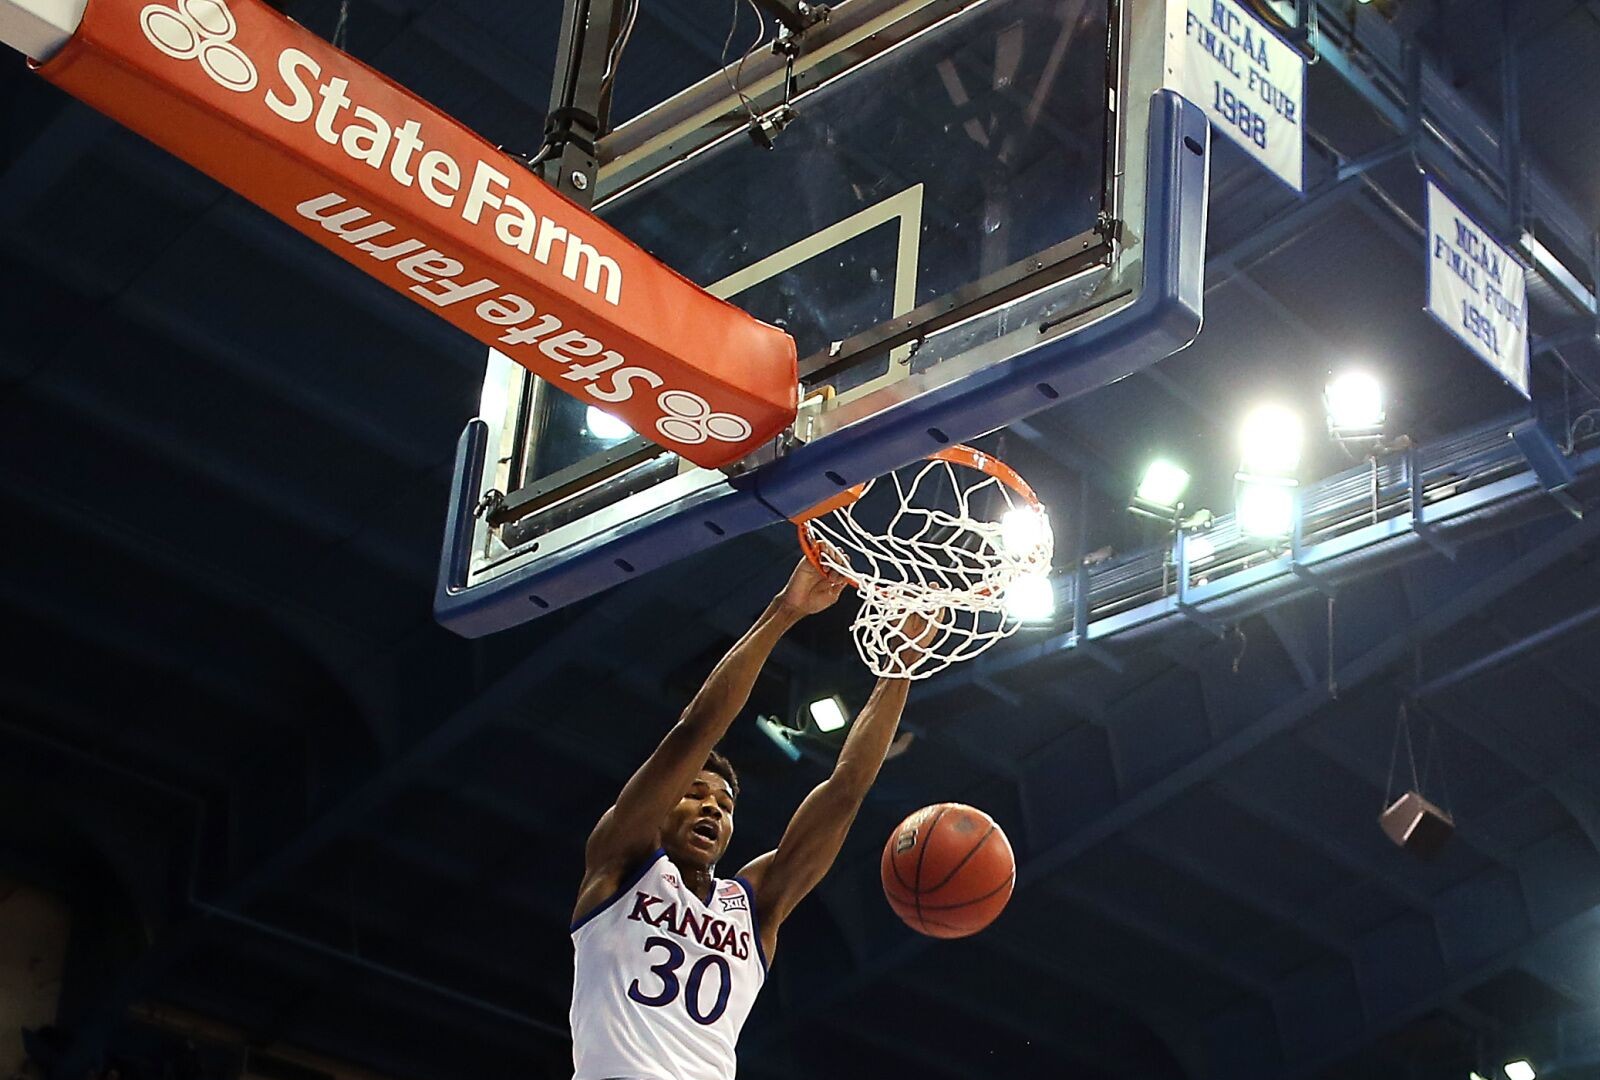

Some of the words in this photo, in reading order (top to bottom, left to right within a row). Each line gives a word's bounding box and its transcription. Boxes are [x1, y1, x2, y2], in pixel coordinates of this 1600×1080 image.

[1214, 80, 1266, 150] 1988
[1248, 66, 1297, 125] FOUR
[628, 891, 750, 960] KANSAS
[627, 936, 731, 1025] 30
